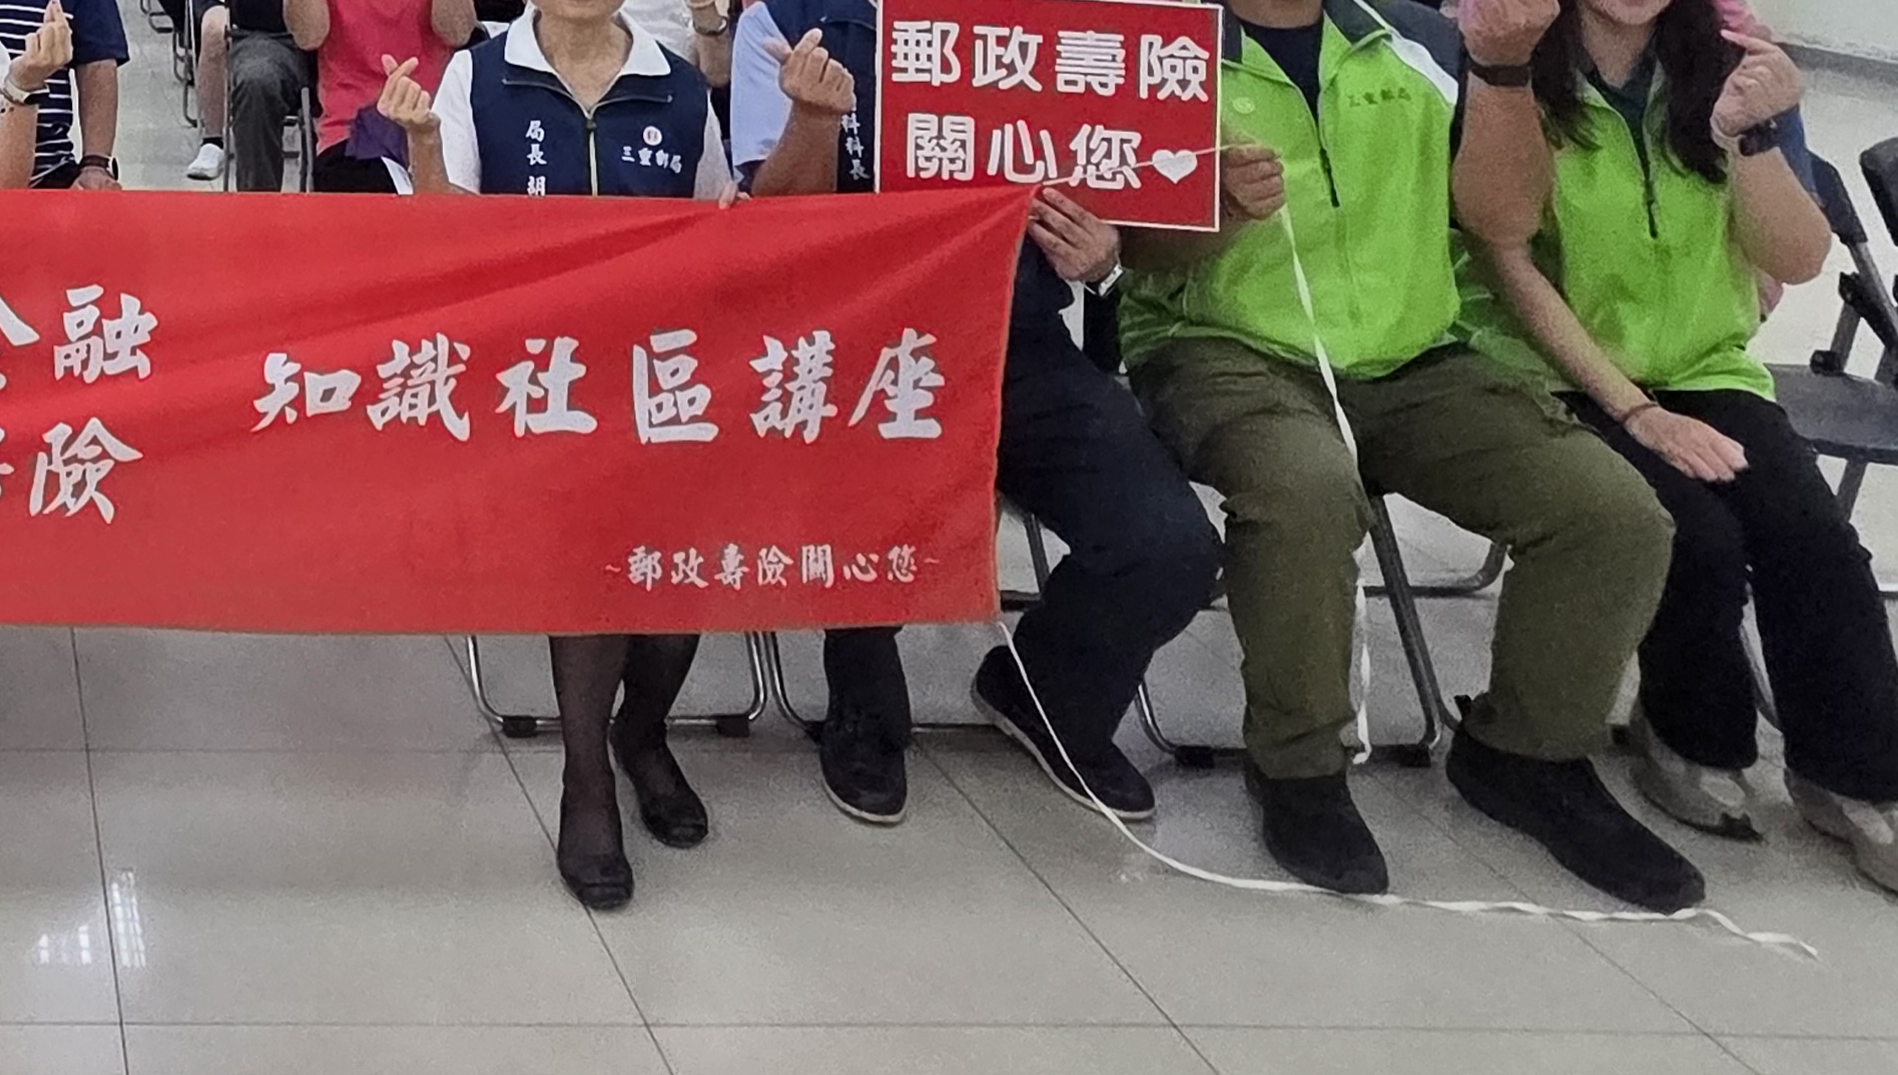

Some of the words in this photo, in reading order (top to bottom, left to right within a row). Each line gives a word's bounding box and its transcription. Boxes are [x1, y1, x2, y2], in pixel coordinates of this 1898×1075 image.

[890, 19, 1210, 103] 郵政壽險
[621, 145, 683, 174] 三重郵局
[906, 112, 1142, 191] 關心您
[250, 326, 946, 445] 知識社區講座
